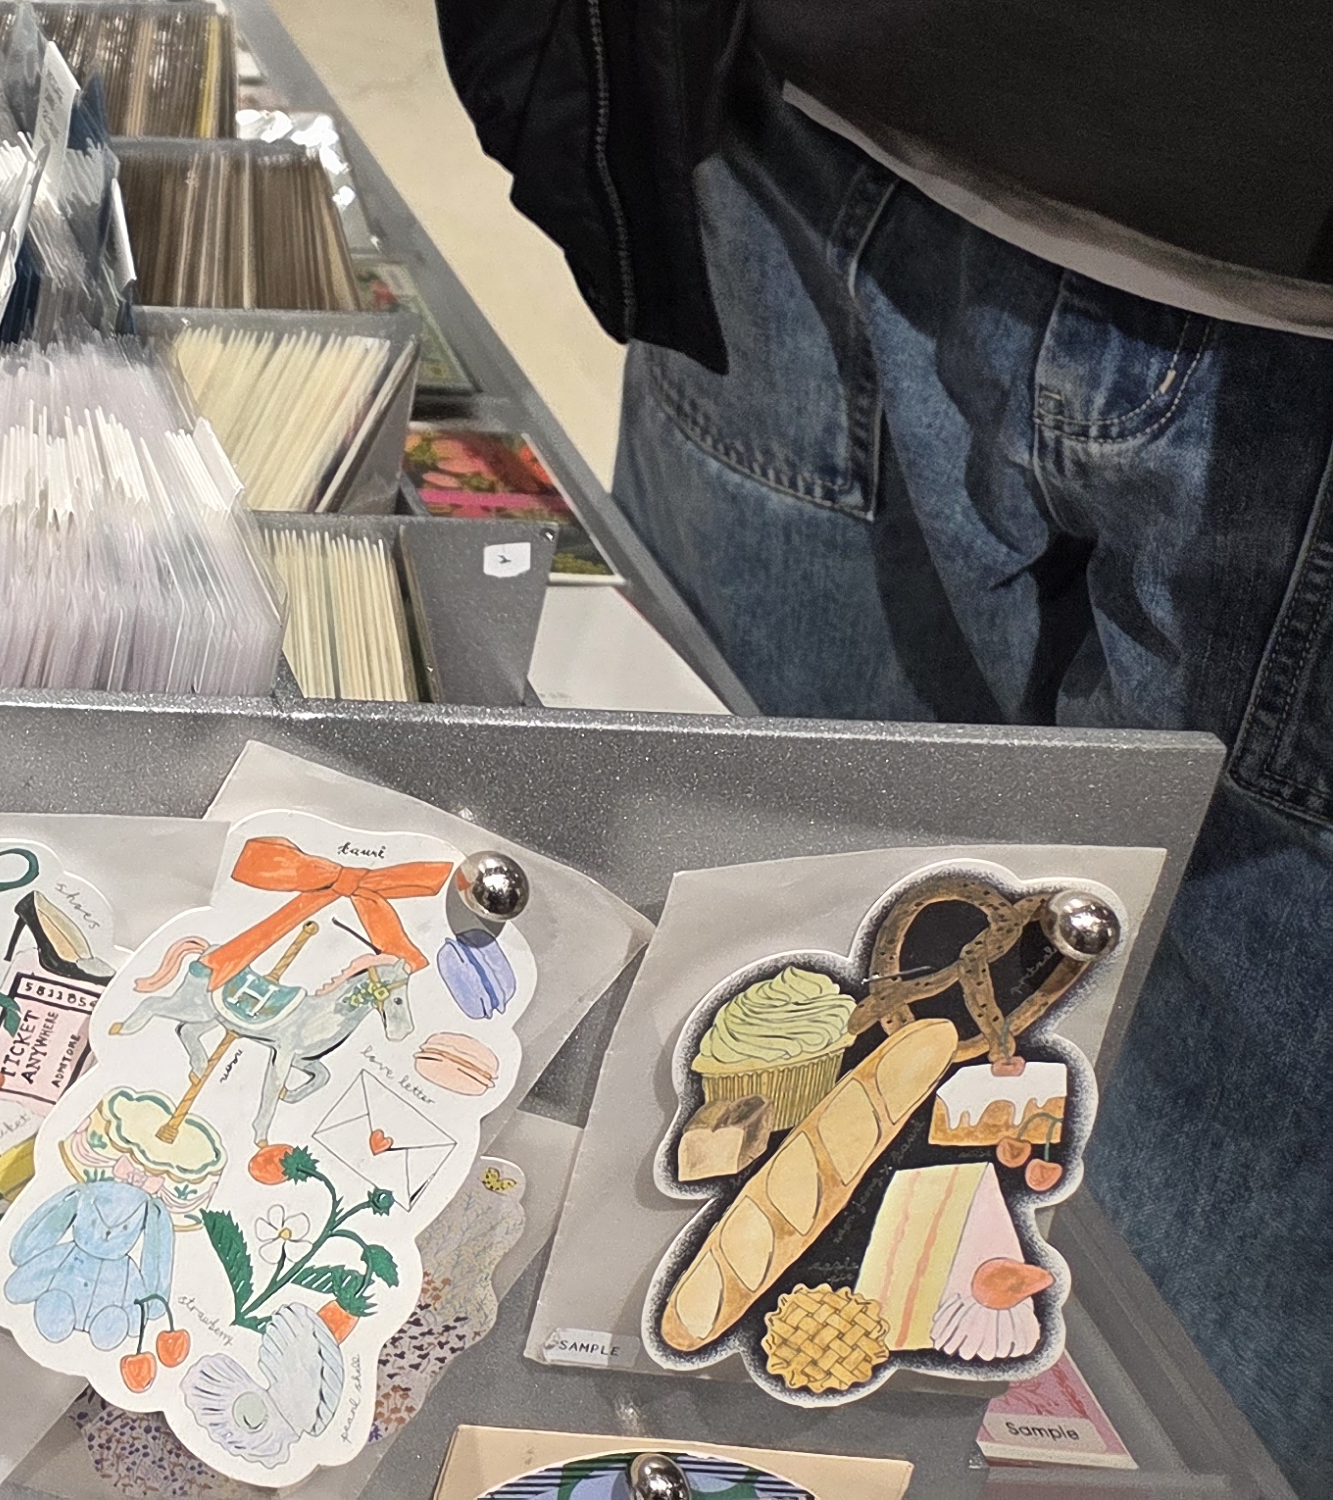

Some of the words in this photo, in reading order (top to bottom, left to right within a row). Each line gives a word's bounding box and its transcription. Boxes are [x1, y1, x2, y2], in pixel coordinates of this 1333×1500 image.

[0, 1011, 40, 1078] TICKET
[21, 1011, 59, 1084] ANYWHERE
[362, 1045, 394, 1080] love
[398, 1074, 435, 1104] letter
[178, 1296, 233, 1347] strawberry
[558, 1340, 621, 1356] SAMPLE
[1006, 1421, 1080, 1441] Sample
